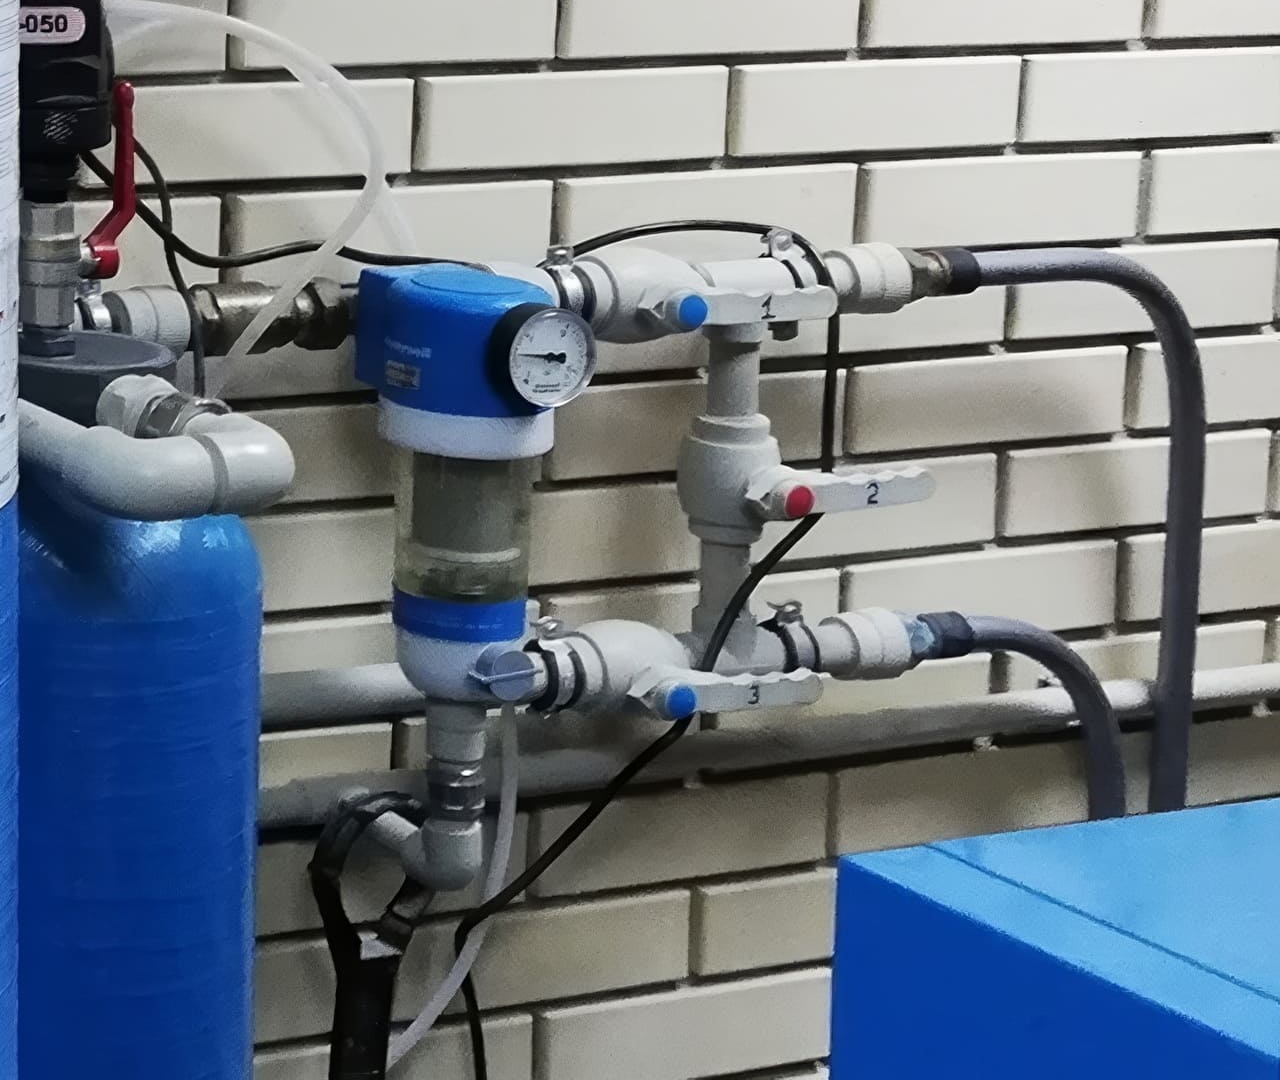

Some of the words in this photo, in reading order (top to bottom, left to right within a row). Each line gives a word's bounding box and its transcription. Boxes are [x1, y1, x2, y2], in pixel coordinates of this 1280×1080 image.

[761, 294, 776, 320] 1
[867, 482, 879, 505] 2
[748, 684, 760, 704] 3
